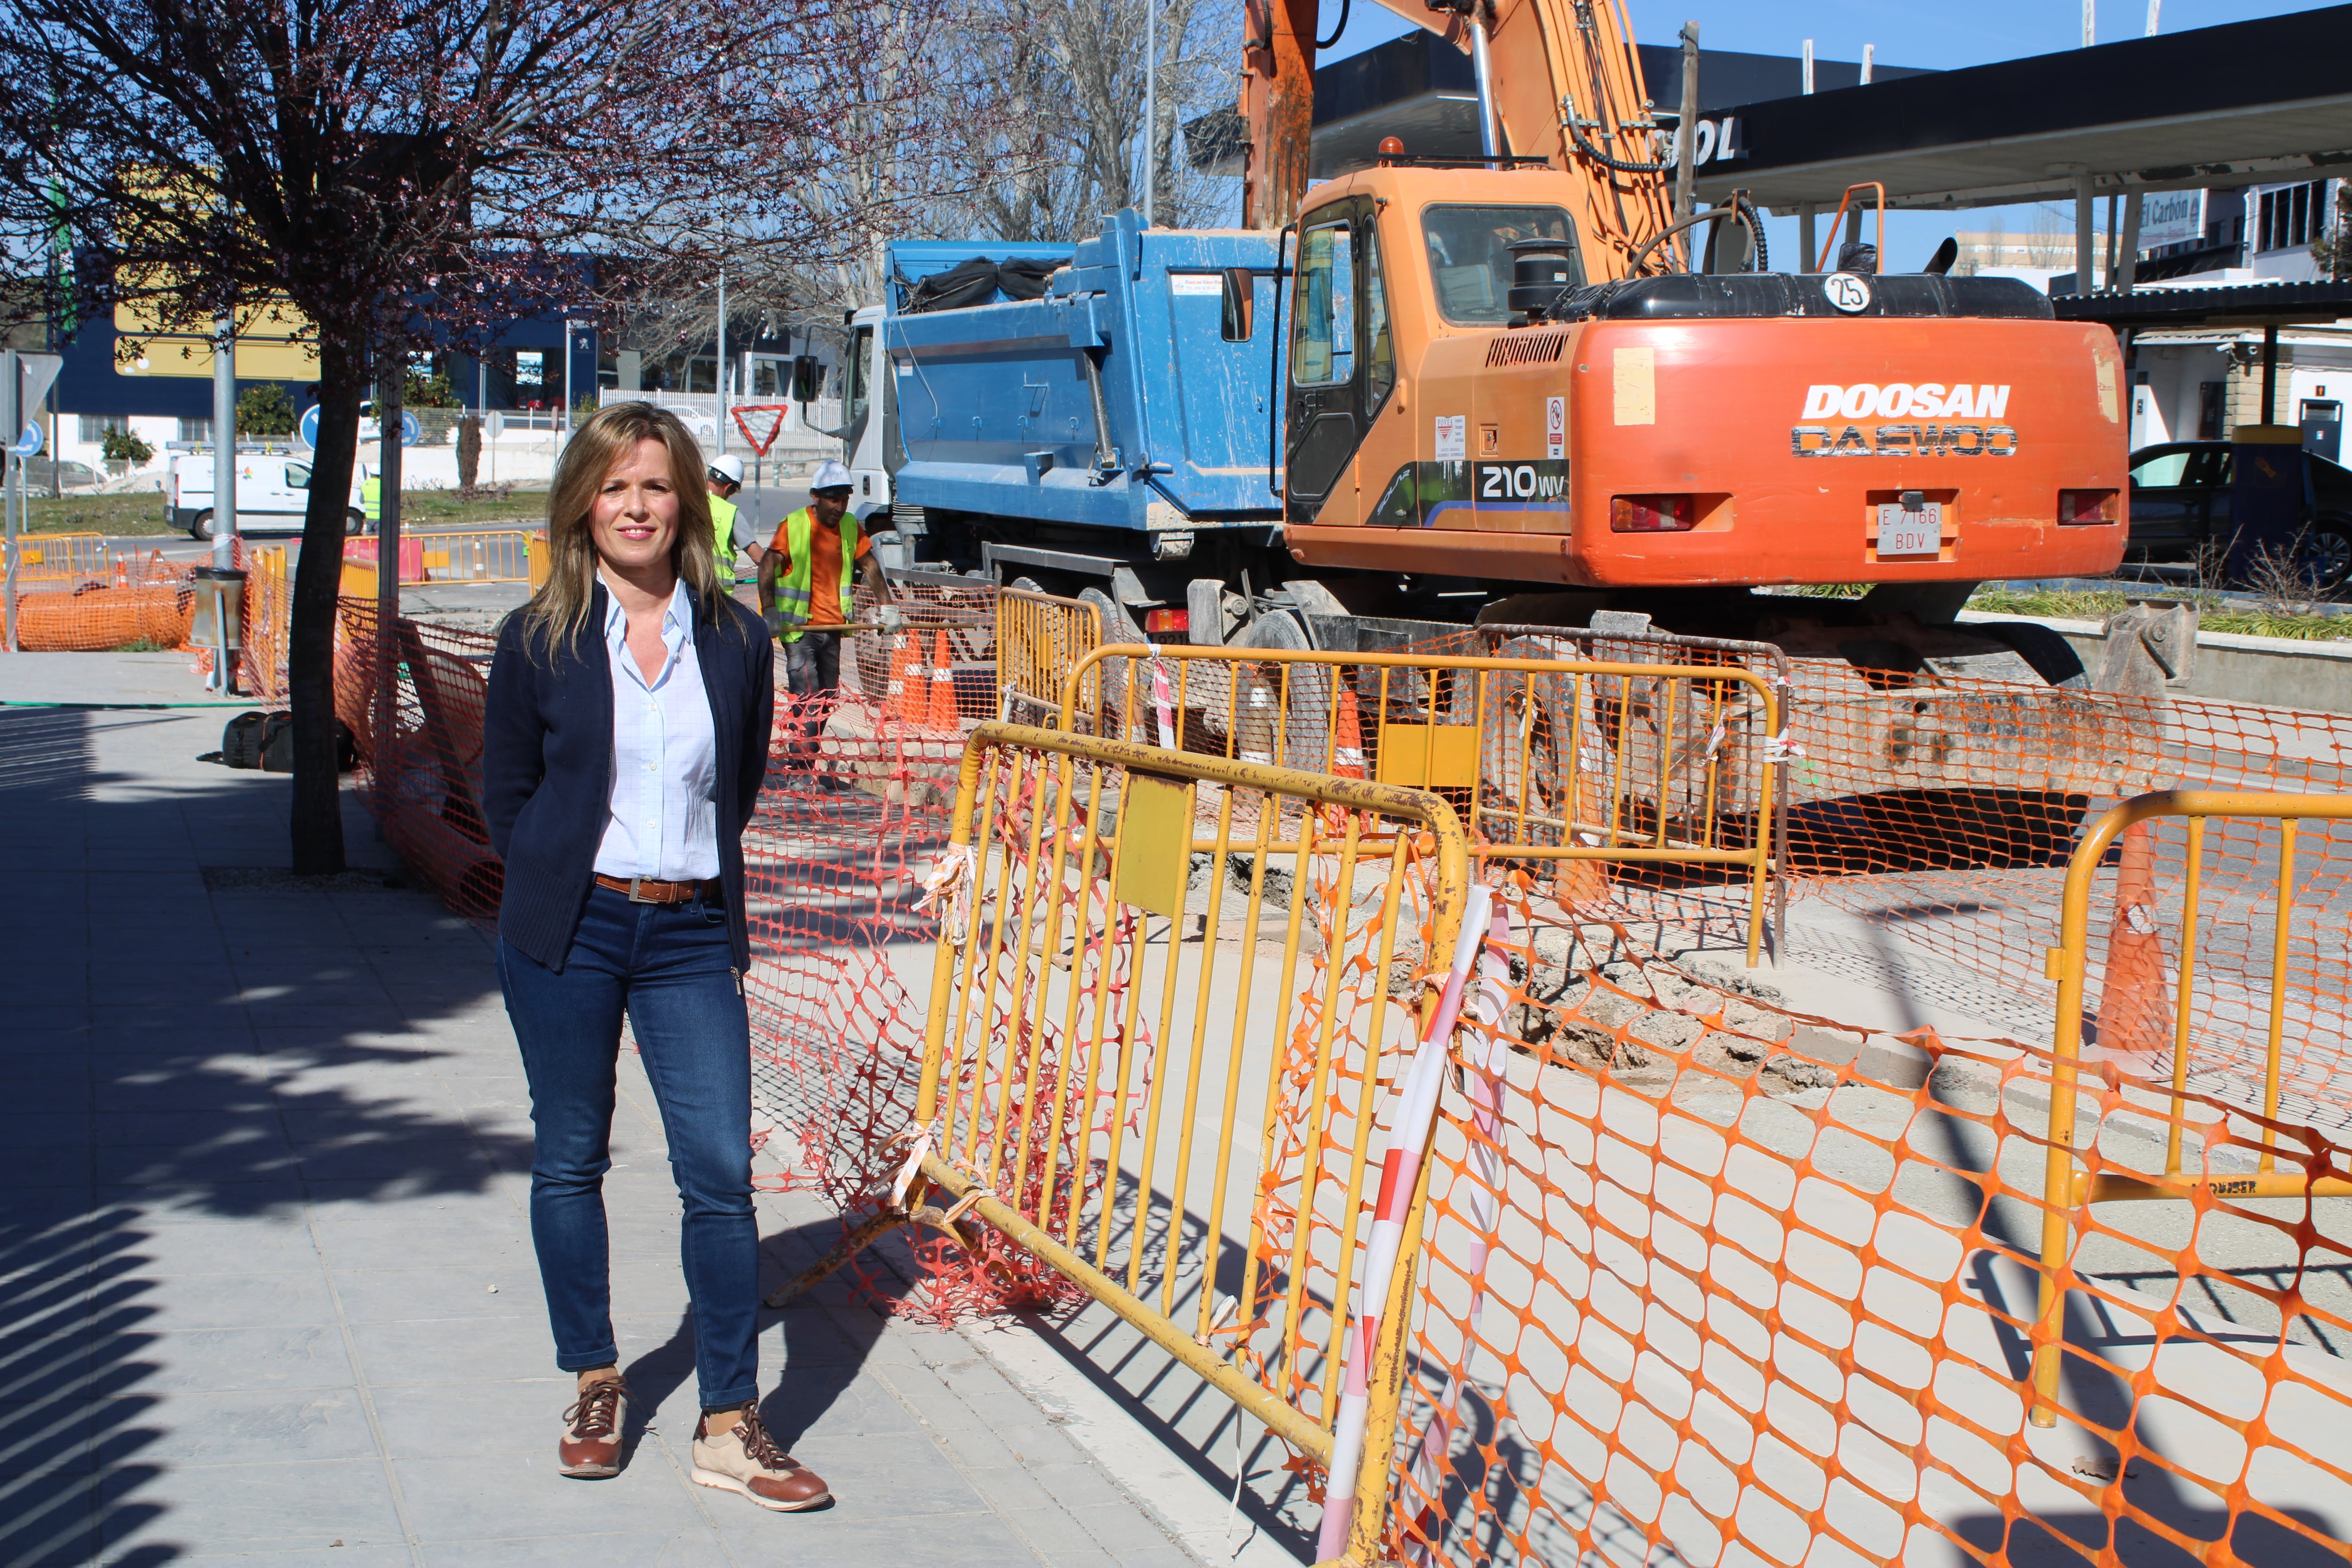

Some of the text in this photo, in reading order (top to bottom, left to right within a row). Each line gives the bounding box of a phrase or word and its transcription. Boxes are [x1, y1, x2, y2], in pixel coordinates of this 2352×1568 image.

[1830, 278, 1863, 306] 25
[1801, 383, 2010, 419] DOOSAN
[1791, 422, 2018, 457] DAEWOO
[1377, 469, 1410, 516] SOLAR
[1483, 465, 1537, 497] 210
[1883, 508, 1937, 525] E 7166
[1896, 533, 1925, 549] BDV
